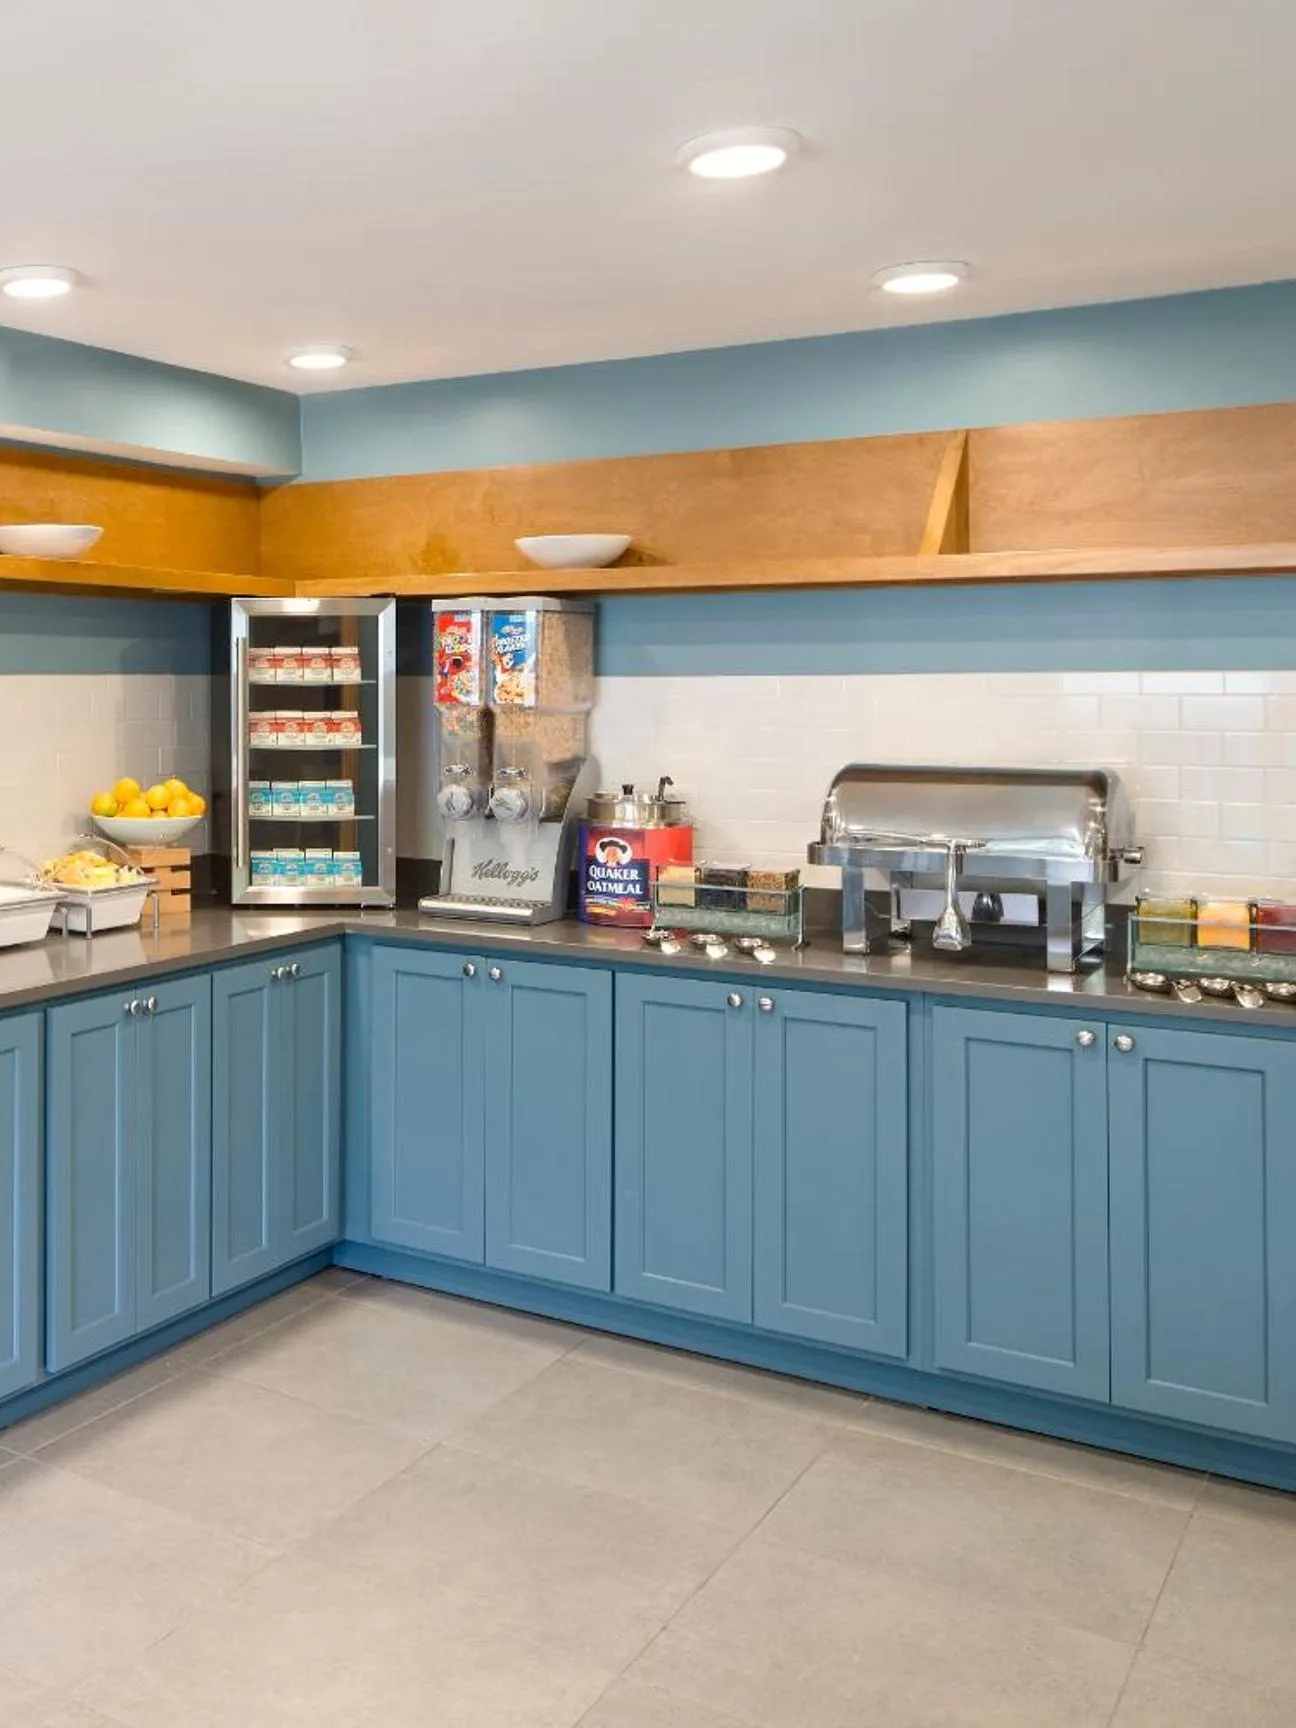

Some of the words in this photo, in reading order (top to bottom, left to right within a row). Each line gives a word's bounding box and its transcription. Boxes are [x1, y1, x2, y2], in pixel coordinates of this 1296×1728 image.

[470, 859, 540, 887] Kellogg's
[589, 865, 641, 880] QUAKER
[587, 880, 643, 895] OATMEAL
